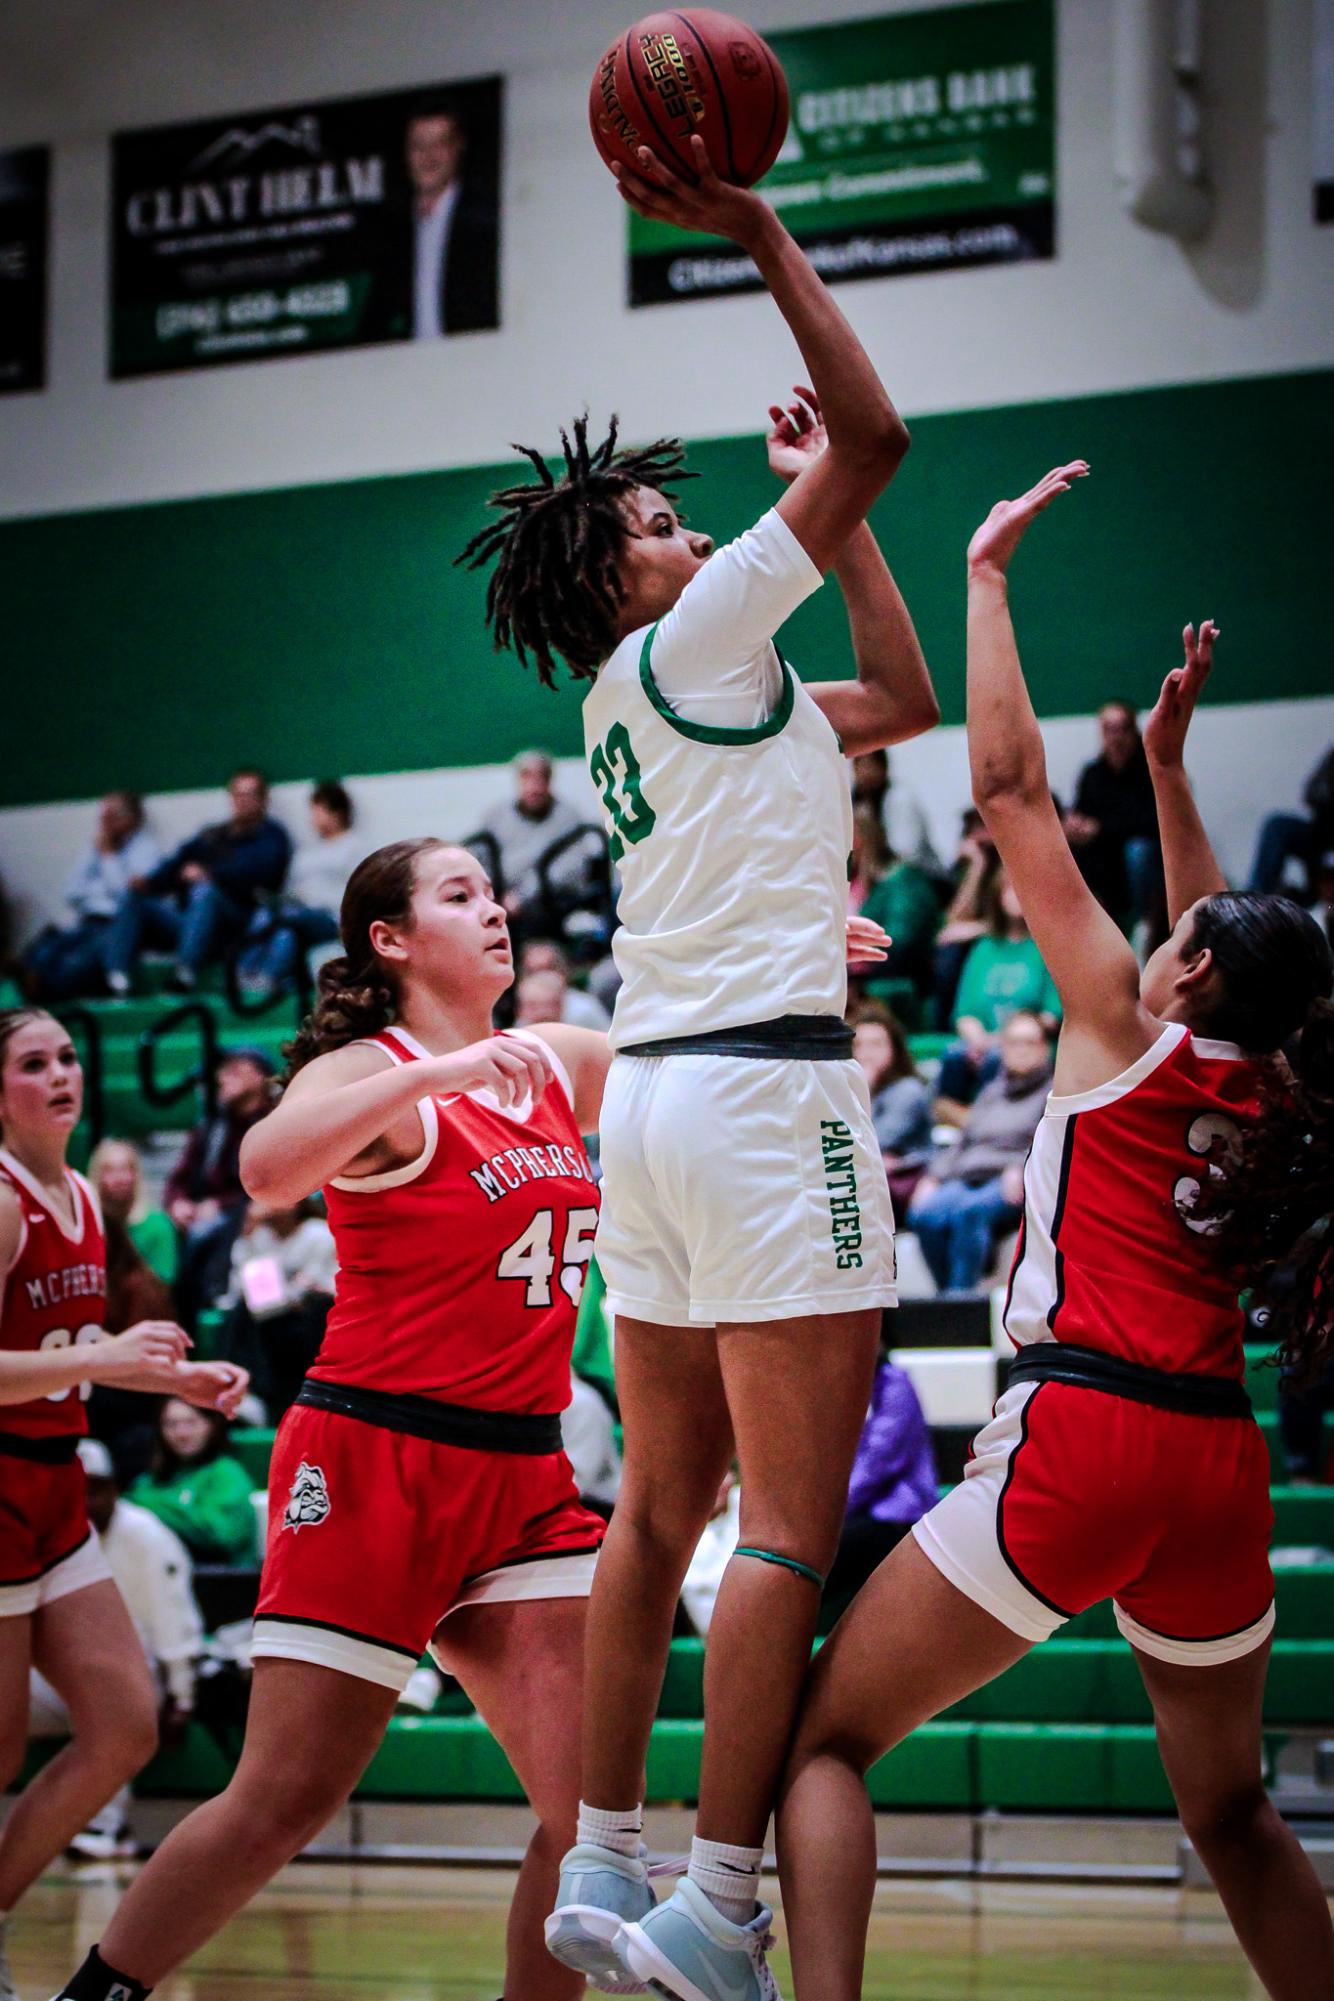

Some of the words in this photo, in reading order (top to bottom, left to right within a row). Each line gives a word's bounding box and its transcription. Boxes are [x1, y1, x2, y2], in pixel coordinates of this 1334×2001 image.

[600, 43, 641, 158] PALDING
[638, 33, 695, 139] LEGACY
[127, 177, 249, 237] CLINT
[820, 1120, 863, 1270] PANTHERS
[496, 1205, 599, 1309] 45
